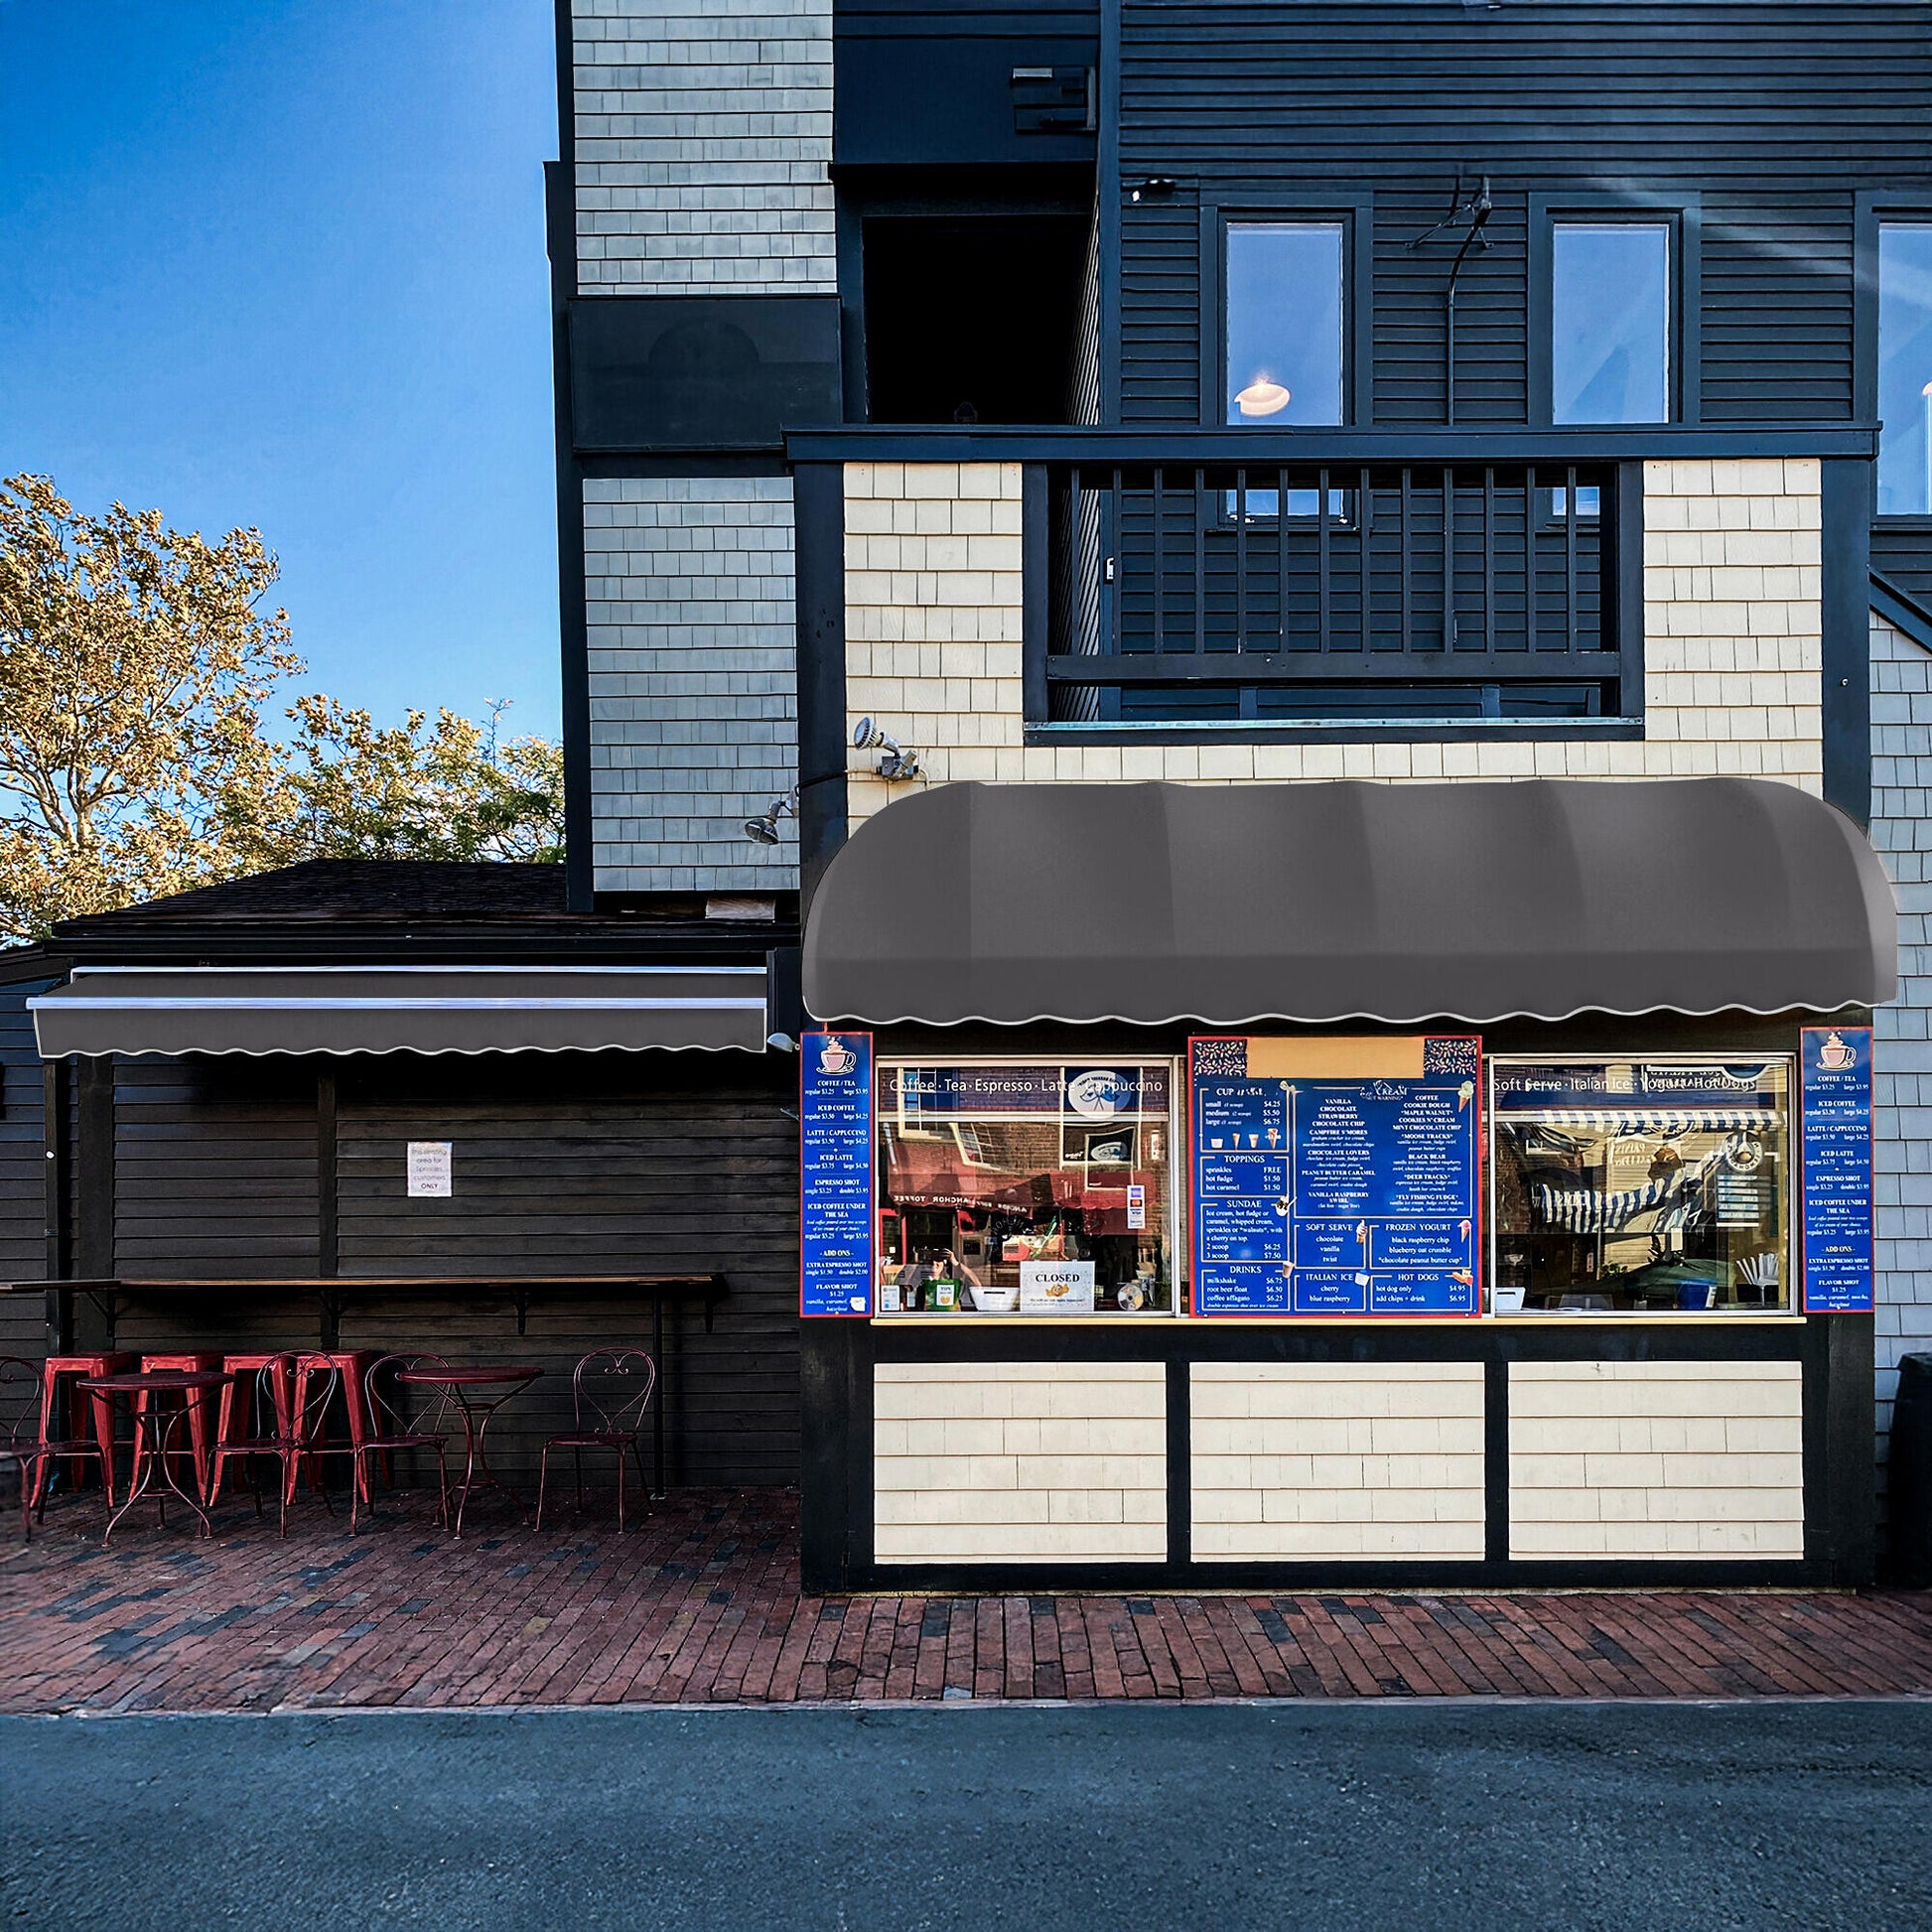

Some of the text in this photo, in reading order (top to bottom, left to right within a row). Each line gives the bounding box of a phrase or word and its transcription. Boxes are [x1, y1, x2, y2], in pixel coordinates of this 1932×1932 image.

[890, 1079, 935, 1092] Coffee
[945, 1079, 967, 1091] Tea
[975, 1079, 1032, 1095] Espresso
[1494, 1078, 1520, 1091] Soft
[1525, 1078, 1562, 1091] Serve
[1571, 1077, 1608, 1090] Italian
[1612, 1078, 1629, 1090] Ice
[1035, 1274, 1080, 1282] CLOSED
